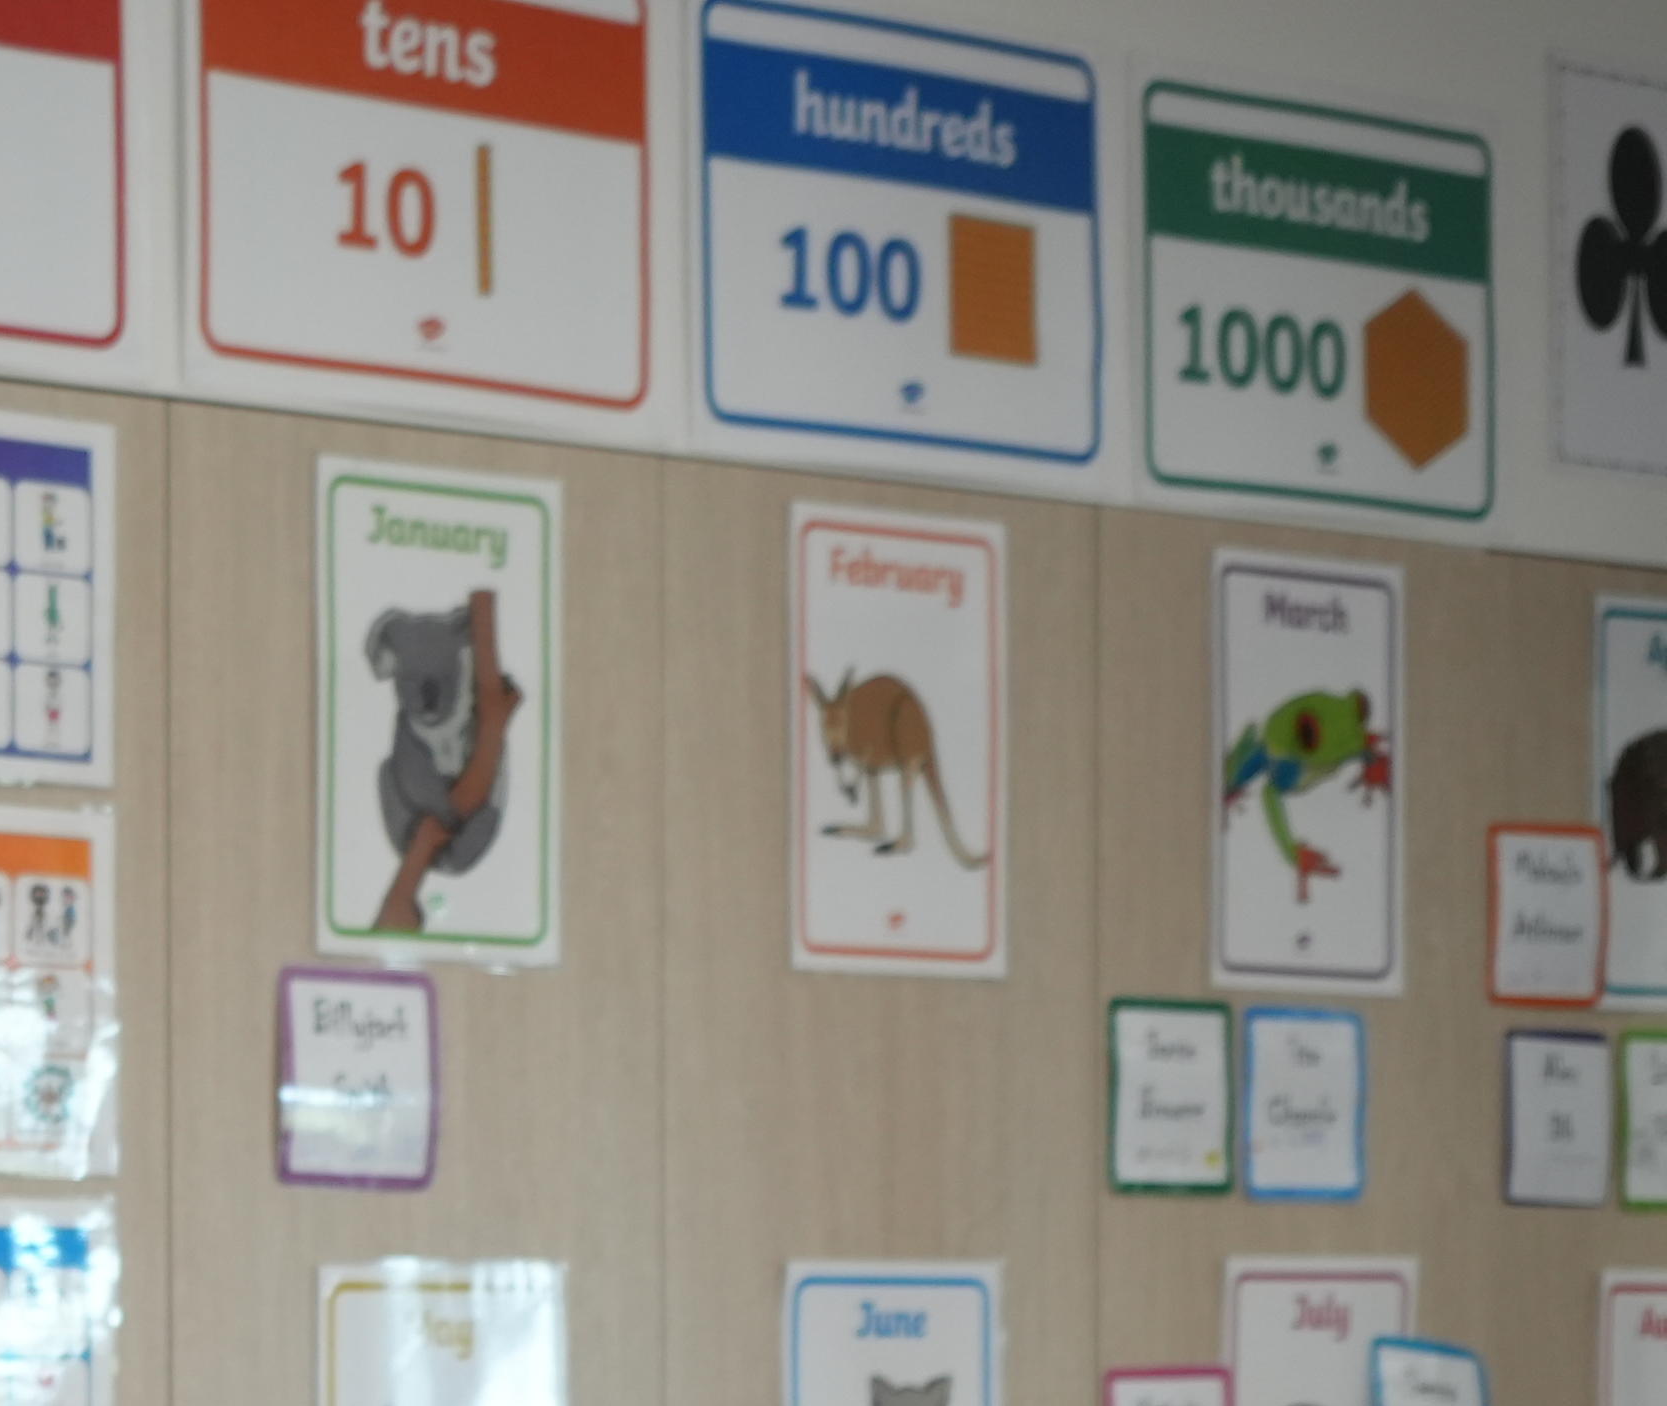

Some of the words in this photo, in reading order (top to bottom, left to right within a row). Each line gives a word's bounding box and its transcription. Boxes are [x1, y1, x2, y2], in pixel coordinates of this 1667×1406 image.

[359, 0, 497, 88] tens
[793, 68, 1017, 169] hundreds
[336, 160, 436, 259] 10
[1211, 152, 1431, 243] thousands
[780, 226, 922, 323] 100
[1179, 304, 1347, 399] 1000
[366, 505, 509, 569] January
[829, 545, 965, 609] February
[1264, 592, 1350, 635] March
[856, 1298, 929, 1340] June
[1292, 1291, 1351, 1340] July
